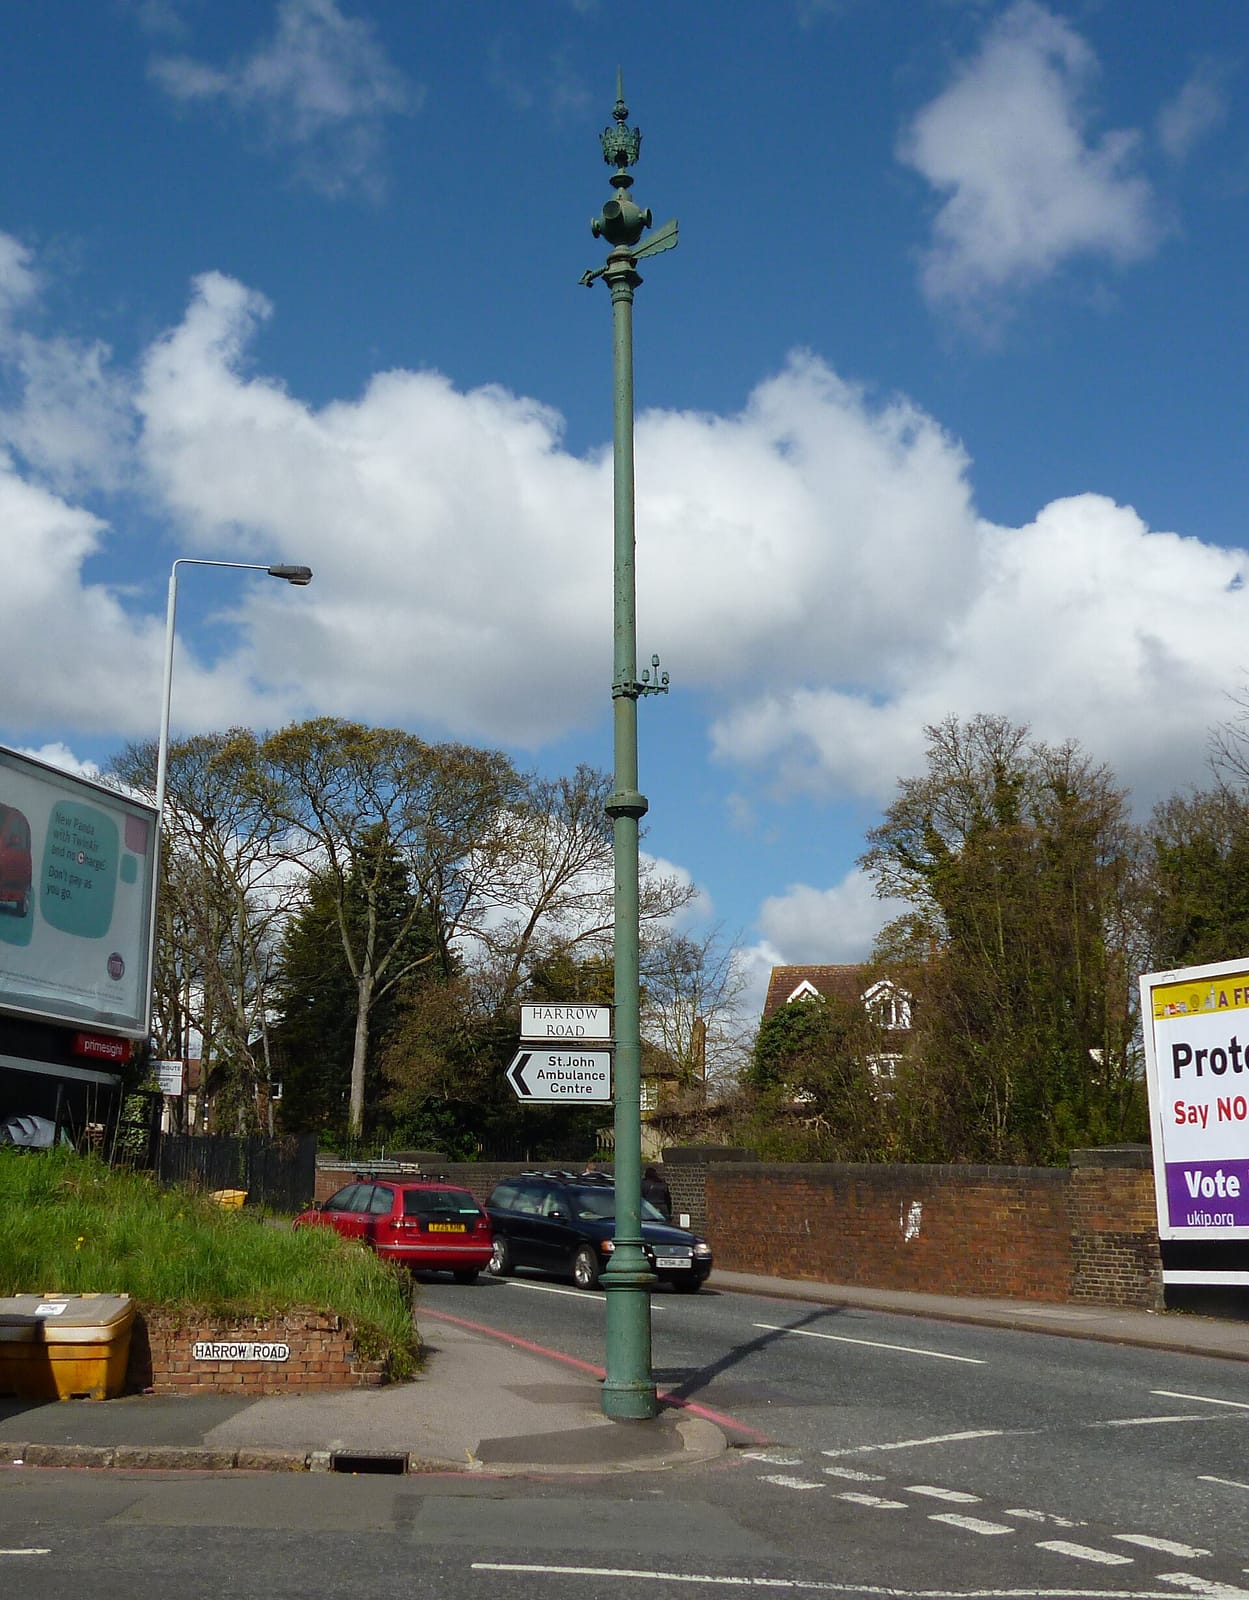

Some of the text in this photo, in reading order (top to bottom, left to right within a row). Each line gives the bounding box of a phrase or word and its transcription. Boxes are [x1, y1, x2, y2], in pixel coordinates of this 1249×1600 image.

[55, 812, 72, 826] New
[52, 829, 71, 843] with
[1218, 990, 1229, 1009] A
[533, 1007, 598, 1020] HARROW
[546, 1024, 585, 1036] ROAD
[84, 1039, 123, 1056] primesight
[1172, 1035, 1249, 1079] Prot
[536, 1069, 606, 1081] Ambulance
[550, 1083, 593, 1094] Centre
[1174, 1095, 1248, 1129] Say NO
[1183, 1169, 1241, 1198] Vote
[1187, 1209, 1234, 1227] ukip.org
[195, 1345, 287, 1359] HARROW ROAD
